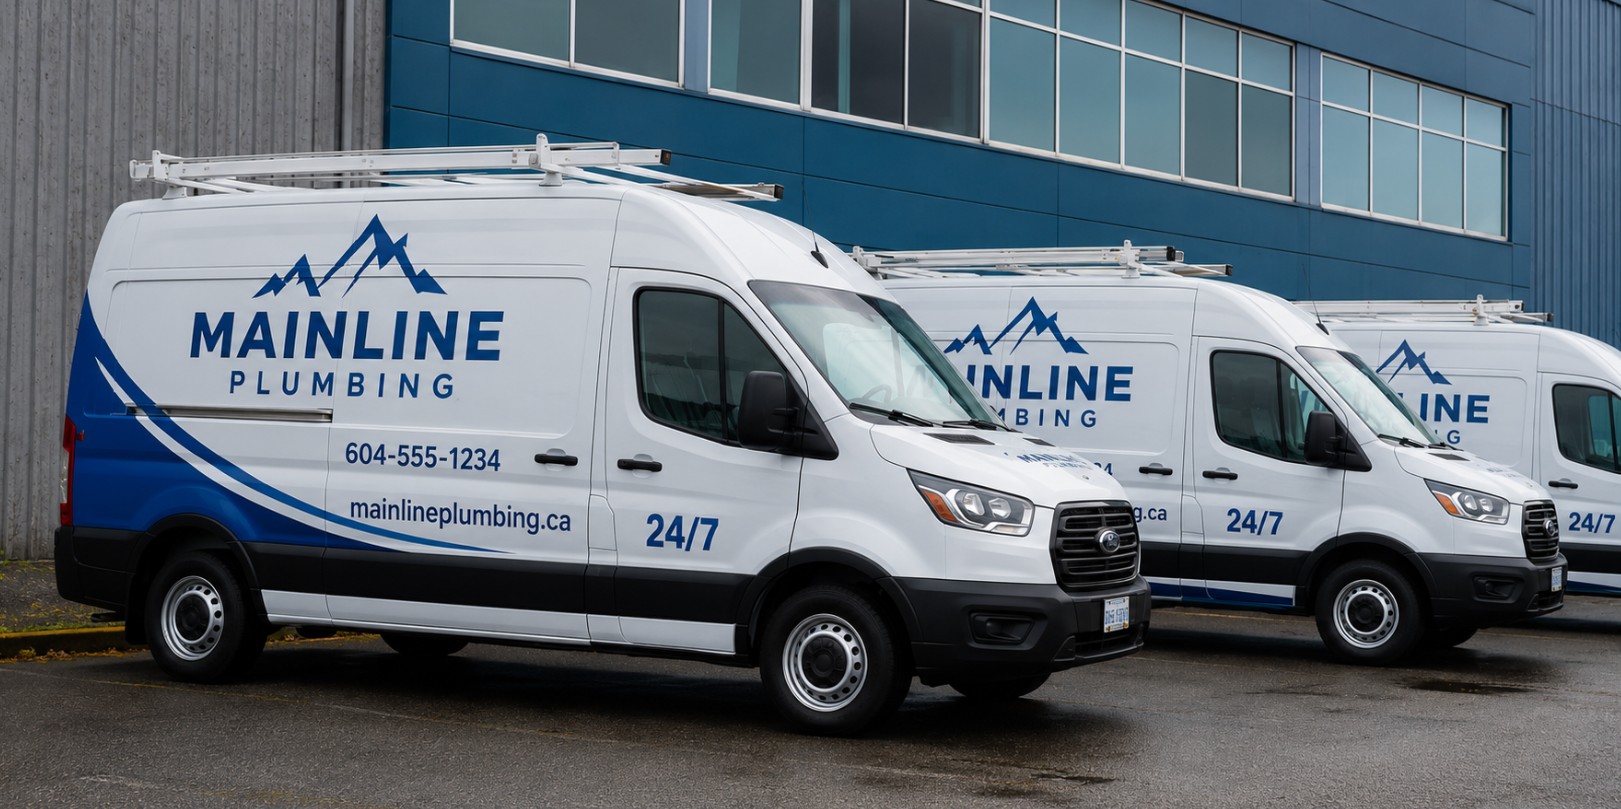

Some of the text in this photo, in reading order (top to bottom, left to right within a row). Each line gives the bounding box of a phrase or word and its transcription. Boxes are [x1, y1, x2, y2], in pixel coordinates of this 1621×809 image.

[189, 310, 505, 361] MAINLINE
[229, 370, 454, 400] PLUMBING
[966, 364, 1134, 402] INLINE
[997, 408, 1097, 428] BING
[345, 442, 502, 472] 604-555-1234
[349, 498, 572, 536] mainlineplumbing.ca
[1226, 507, 1284, 536] 24/7
[1568, 511, 1616, 534] 24/7
[646, 513, 719, 552] 24/7
